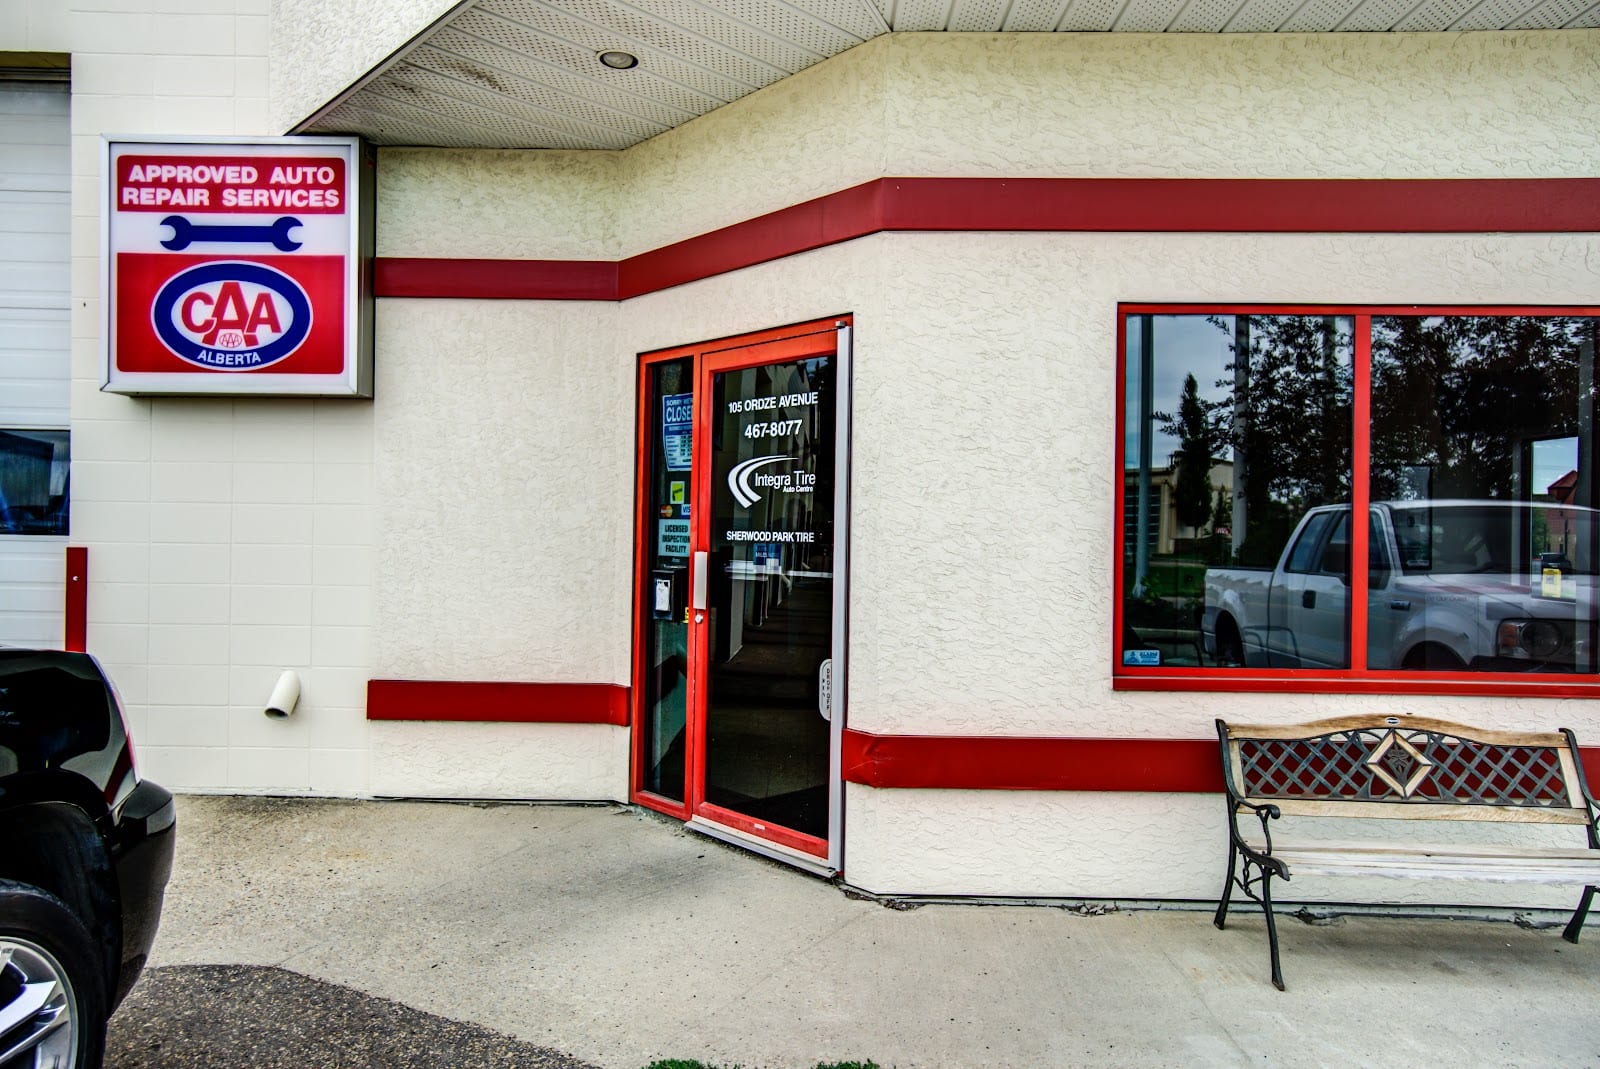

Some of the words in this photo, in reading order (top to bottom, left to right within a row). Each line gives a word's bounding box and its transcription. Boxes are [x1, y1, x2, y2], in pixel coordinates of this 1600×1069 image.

[128, 164, 259, 184] APPROVED
[269, 166, 335, 185] AUTO
[122, 187, 210, 206] REPAIR
[222, 189, 339, 207] SERVICES
[181, 281, 282, 348] CAA
[197, 350, 261, 366] ALBERTA
[728, 401, 743, 413] 105
[744, 397, 777, 412] ORDZE
[778, 392, 819, 408] AVENUE
[666, 405, 693, 422] CLOSE
[744, 419, 803, 439] 467-8077
[755, 472, 791, 489] Integra
[793, 470, 816, 485] Tire
[664, 524, 688, 533] LICENSED
[726, 530, 772, 541] SHERWOOD
[772, 531, 795, 542] PARK
[795, 532, 815, 543] TIRE
[665, 544, 687, 553] FACILITY
